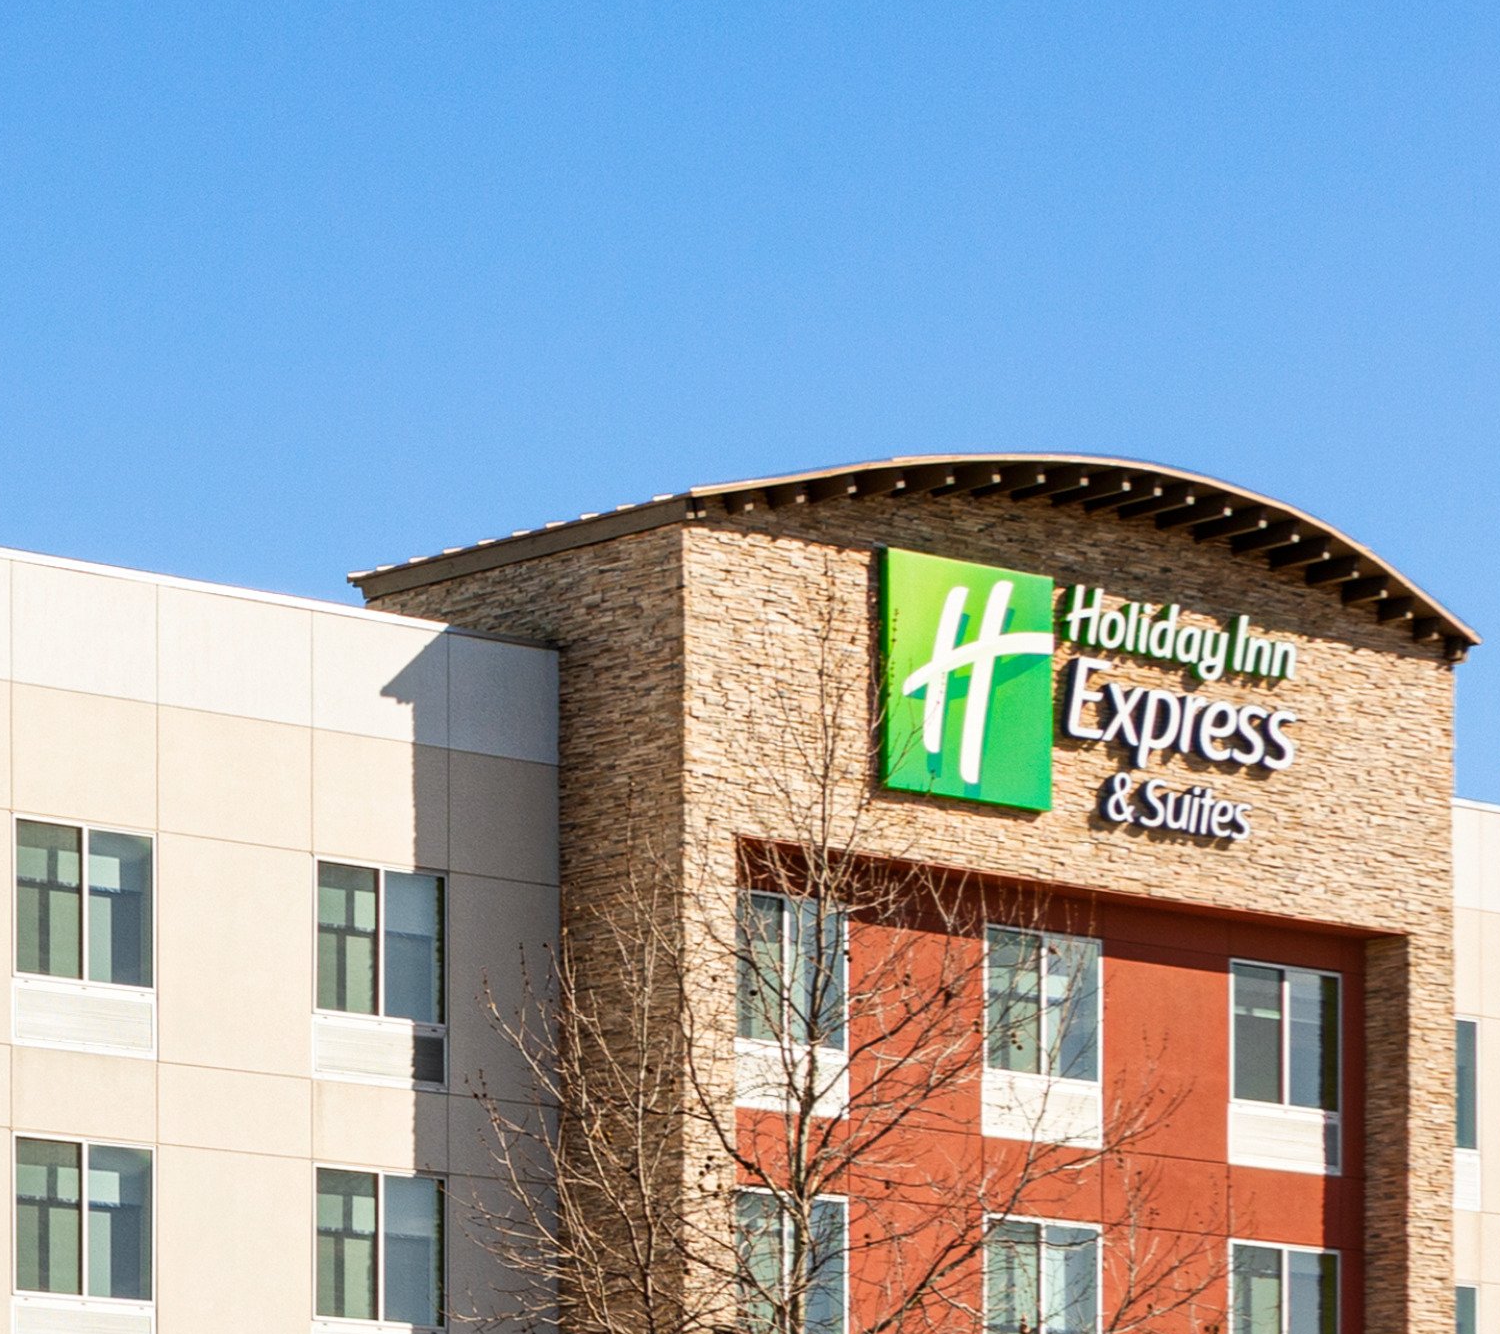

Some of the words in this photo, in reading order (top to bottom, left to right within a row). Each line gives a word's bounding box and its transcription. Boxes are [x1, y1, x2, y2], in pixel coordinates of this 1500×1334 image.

[1066, 584, 1229, 680] Holiday
[1234, 614, 1296, 680] Inn
[1068, 658, 1296, 770] Express
[1107, 772, 1134, 823] &
[1140, 779, 1252, 840] Suites
